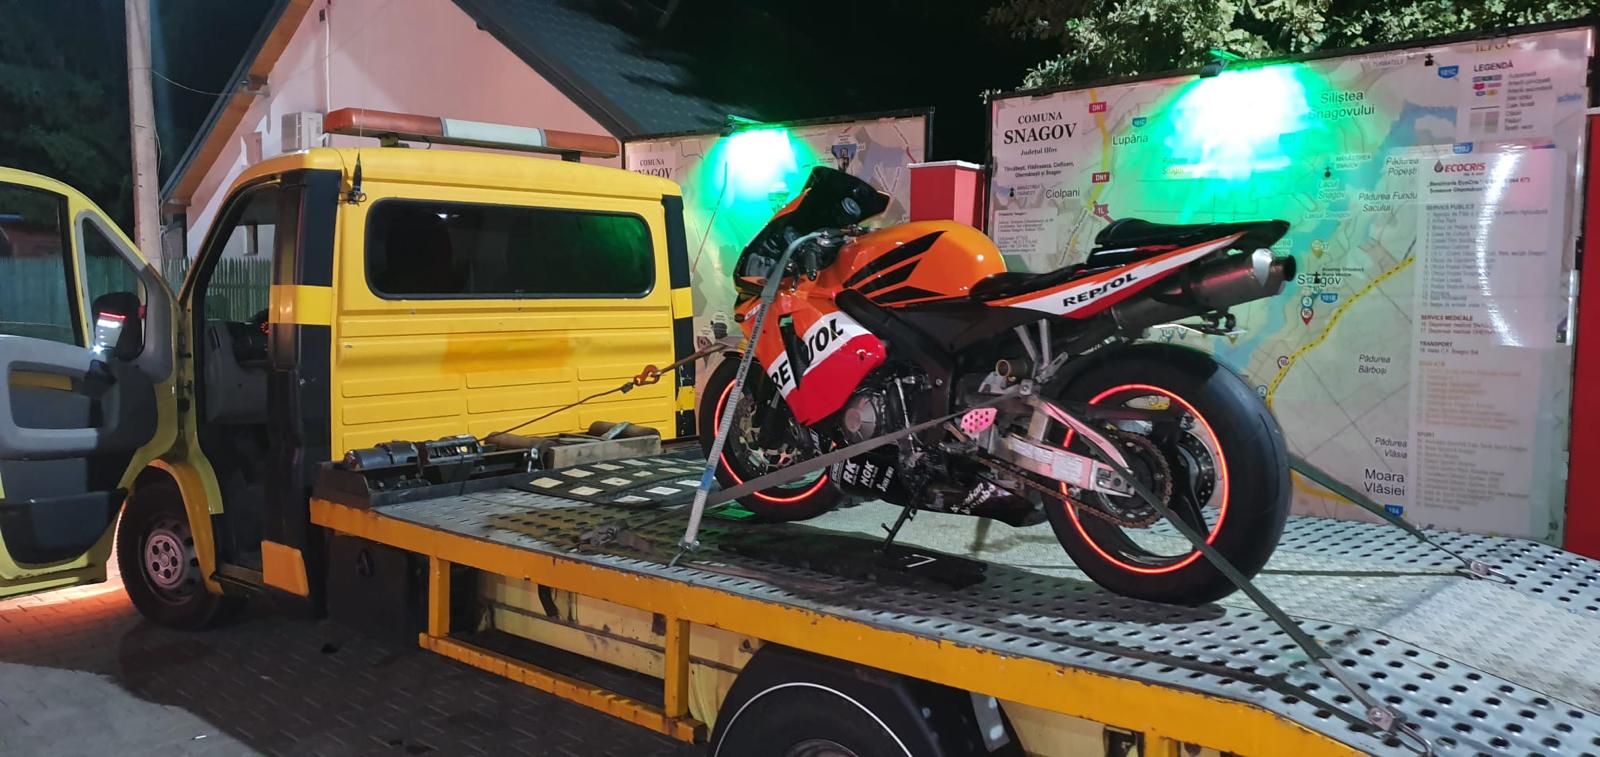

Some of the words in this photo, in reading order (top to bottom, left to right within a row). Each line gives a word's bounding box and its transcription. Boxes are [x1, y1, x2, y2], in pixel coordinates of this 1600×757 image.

[1320, 91, 1364, 104] Siliștea
[1017, 111, 1063, 125] COMUNA
[1003, 122, 1078, 145] SNAGOV
[639, 157, 665, 167] COMUNA
[1444, 162, 1487, 173] ECOCRIS
[633, 167, 673, 179] NAGOV
[1045, 187, 1081, 199] Ciolpani
[1062, 273, 1138, 307] REPSOL
[842, 457, 857, 484] RK
[859, 459, 875, 488] NGK
[1364, 467, 1405, 483] Moara
